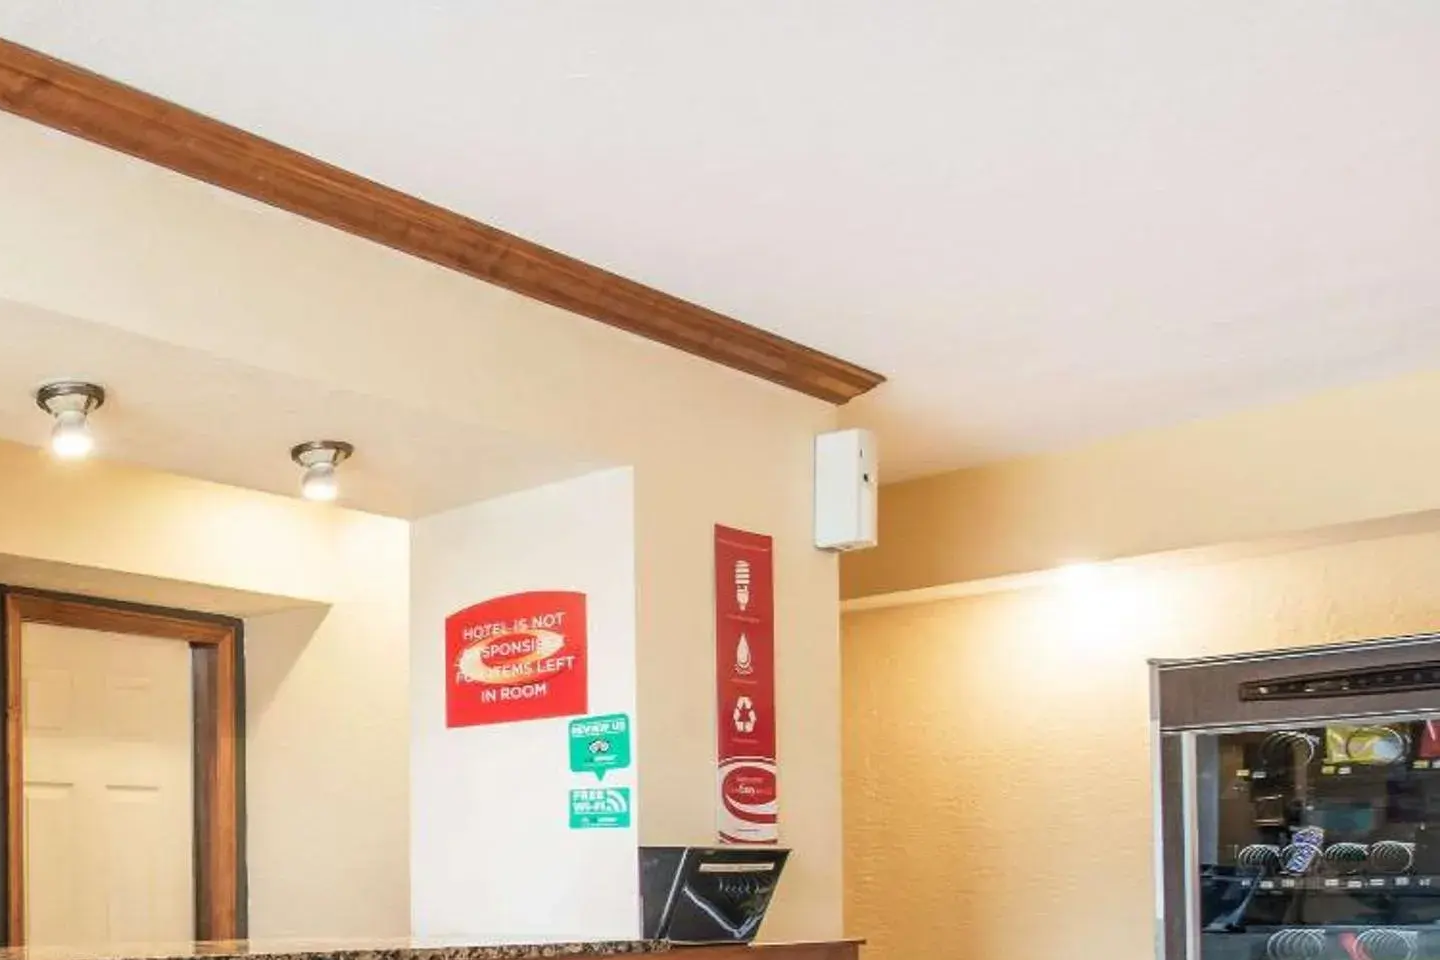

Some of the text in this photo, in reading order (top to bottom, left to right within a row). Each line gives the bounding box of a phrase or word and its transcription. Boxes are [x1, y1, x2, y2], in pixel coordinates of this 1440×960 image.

[463, 611, 566, 640] HOTEL IS NOT
[537, 655, 575, 673] LEFT
[480, 683, 547, 704] IN ROOM
